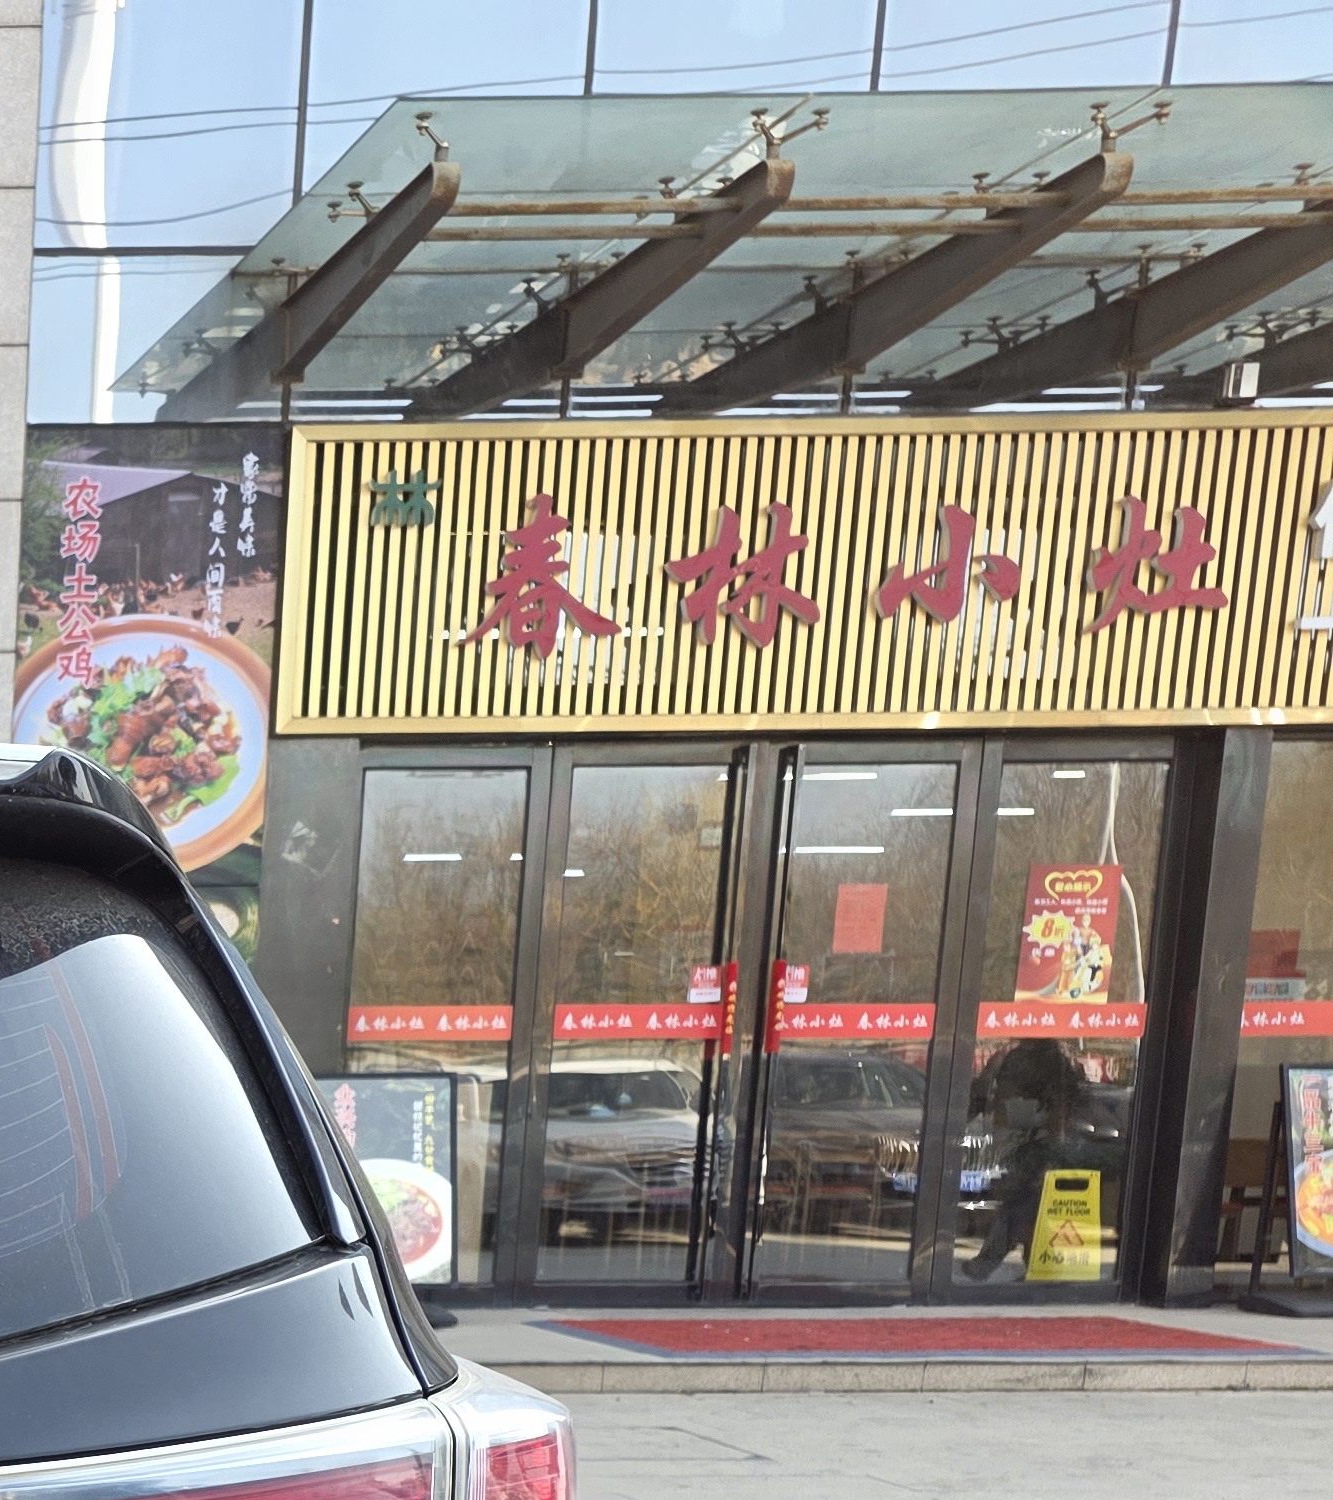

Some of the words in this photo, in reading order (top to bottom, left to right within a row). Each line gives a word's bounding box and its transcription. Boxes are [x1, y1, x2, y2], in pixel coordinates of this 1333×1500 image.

[57, 474, 103, 690] 农场土公鸡
[455, 492, 1228, 660] 春林小灶
